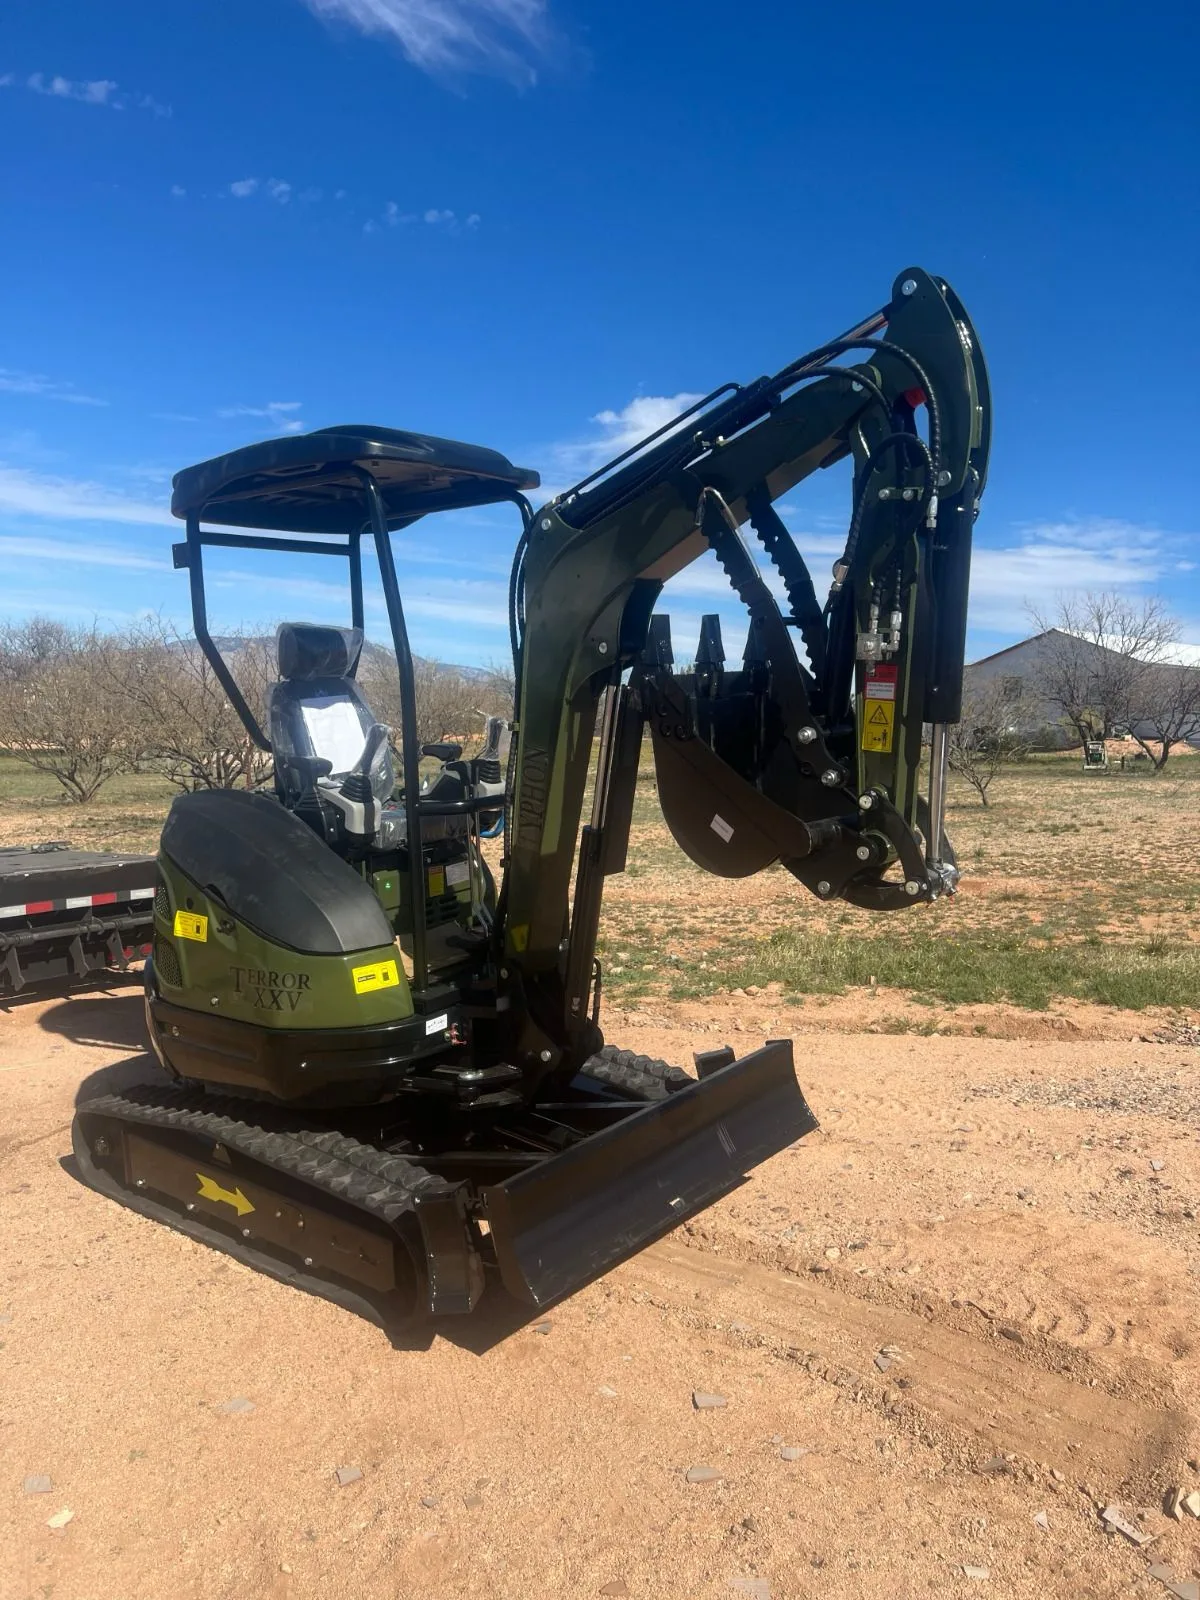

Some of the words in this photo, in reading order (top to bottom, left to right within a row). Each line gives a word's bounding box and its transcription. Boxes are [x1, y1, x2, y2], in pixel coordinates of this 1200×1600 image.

[517, 744, 549, 848] TYPHON
[229, 966, 312, 992] TERROR
[253, 987, 303, 1011] XXV
